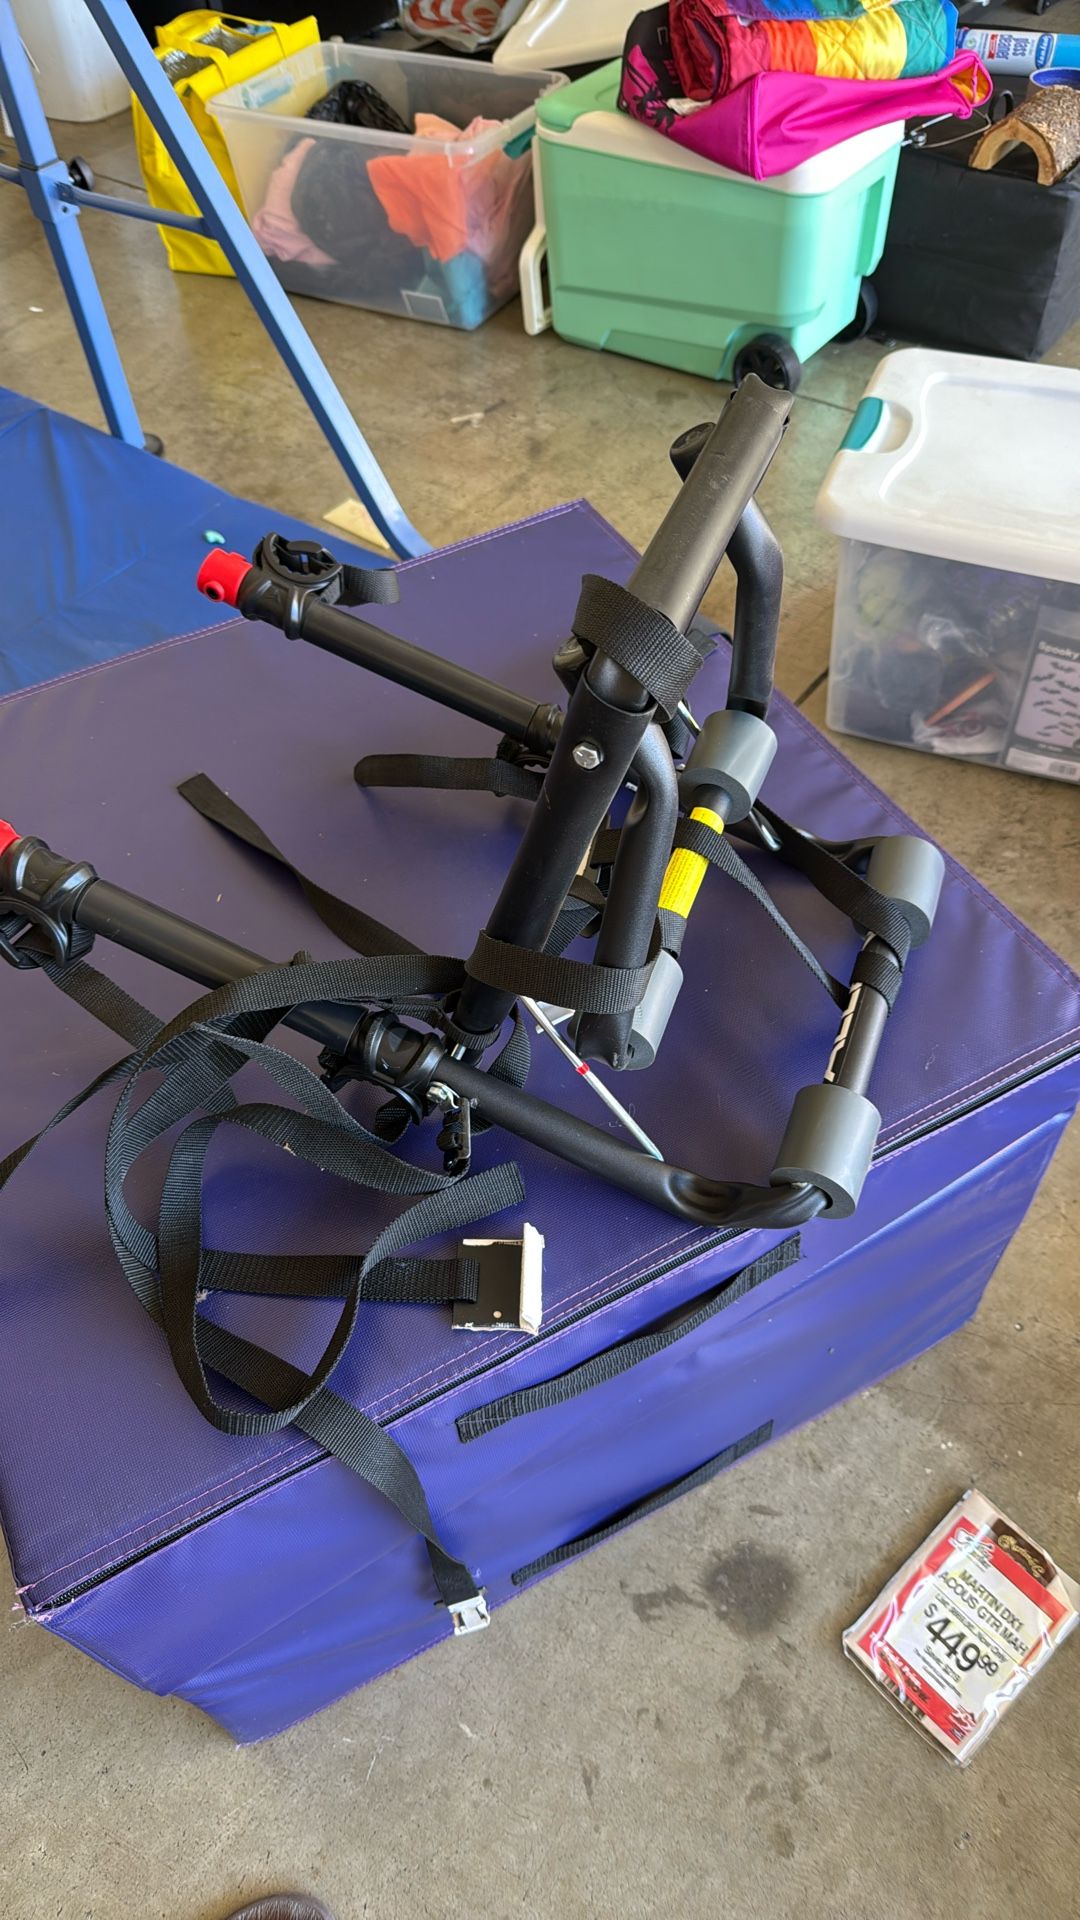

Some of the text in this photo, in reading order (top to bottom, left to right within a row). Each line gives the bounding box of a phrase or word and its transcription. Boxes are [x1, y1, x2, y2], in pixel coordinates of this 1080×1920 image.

[1038, 641, 1080, 660] Spooky
[938, 1570, 979, 1610] ACOUS
[975, 1605, 1003, 1632] GTR
[998, 1626, 1029, 1656] MAH
[958, 1569, 1004, 1612] MARTIN
[999, 1608, 1024, 1632] DX1
